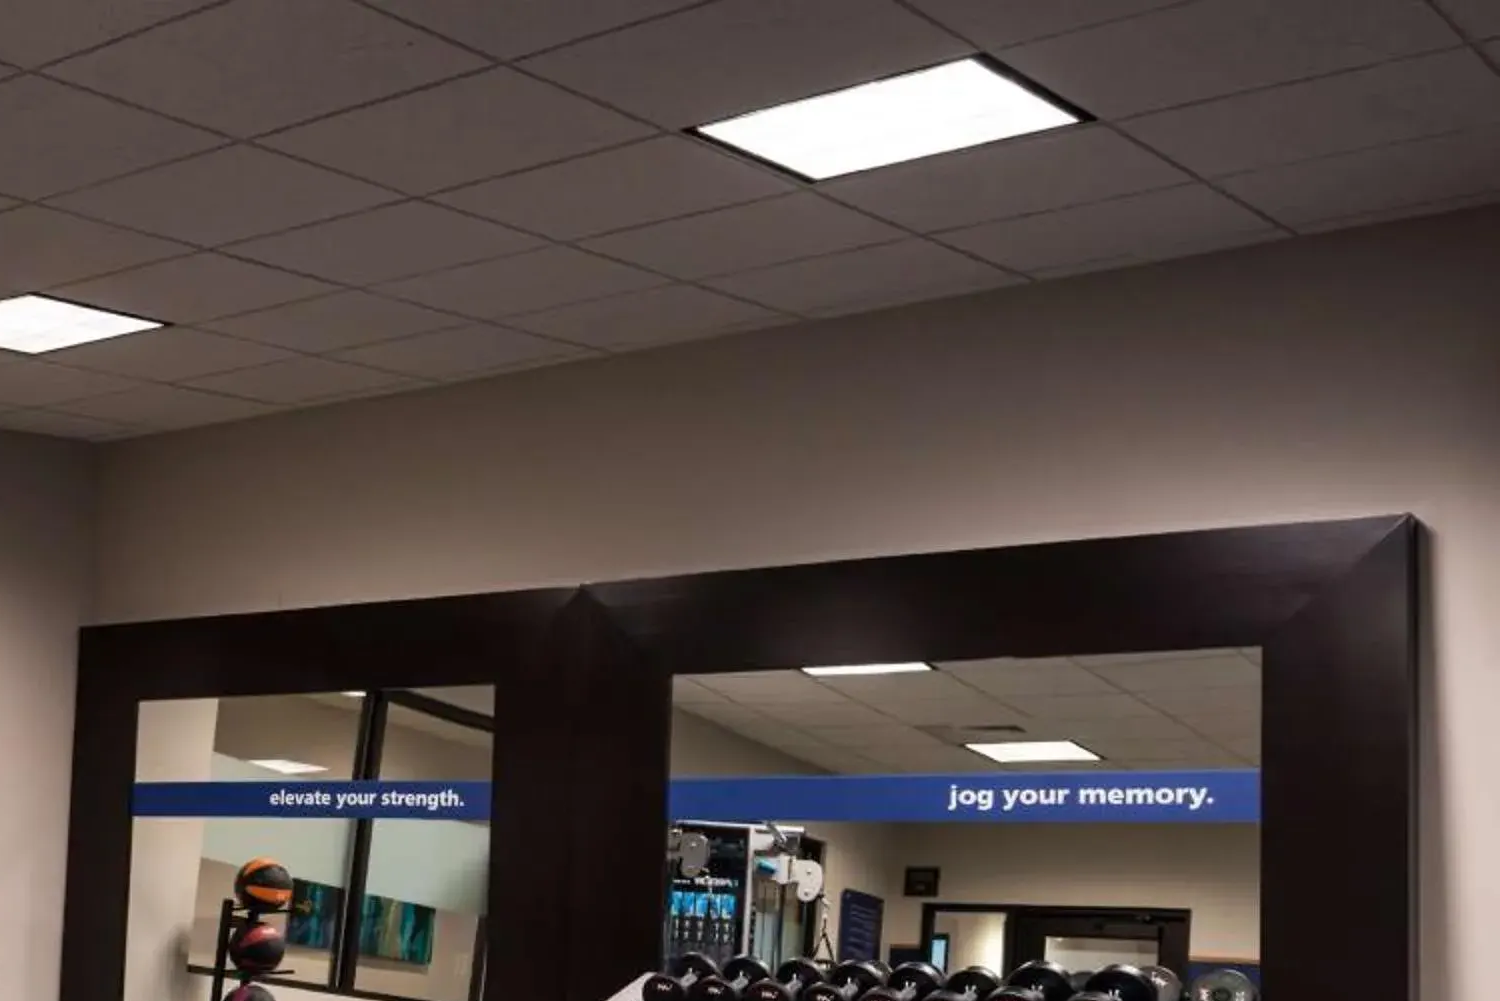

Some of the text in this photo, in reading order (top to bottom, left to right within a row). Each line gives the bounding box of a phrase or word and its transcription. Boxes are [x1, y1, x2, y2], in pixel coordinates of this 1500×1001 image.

[269, 789, 465, 811] elevate your strength.
[948, 784, 1215, 811] jog your memory.
